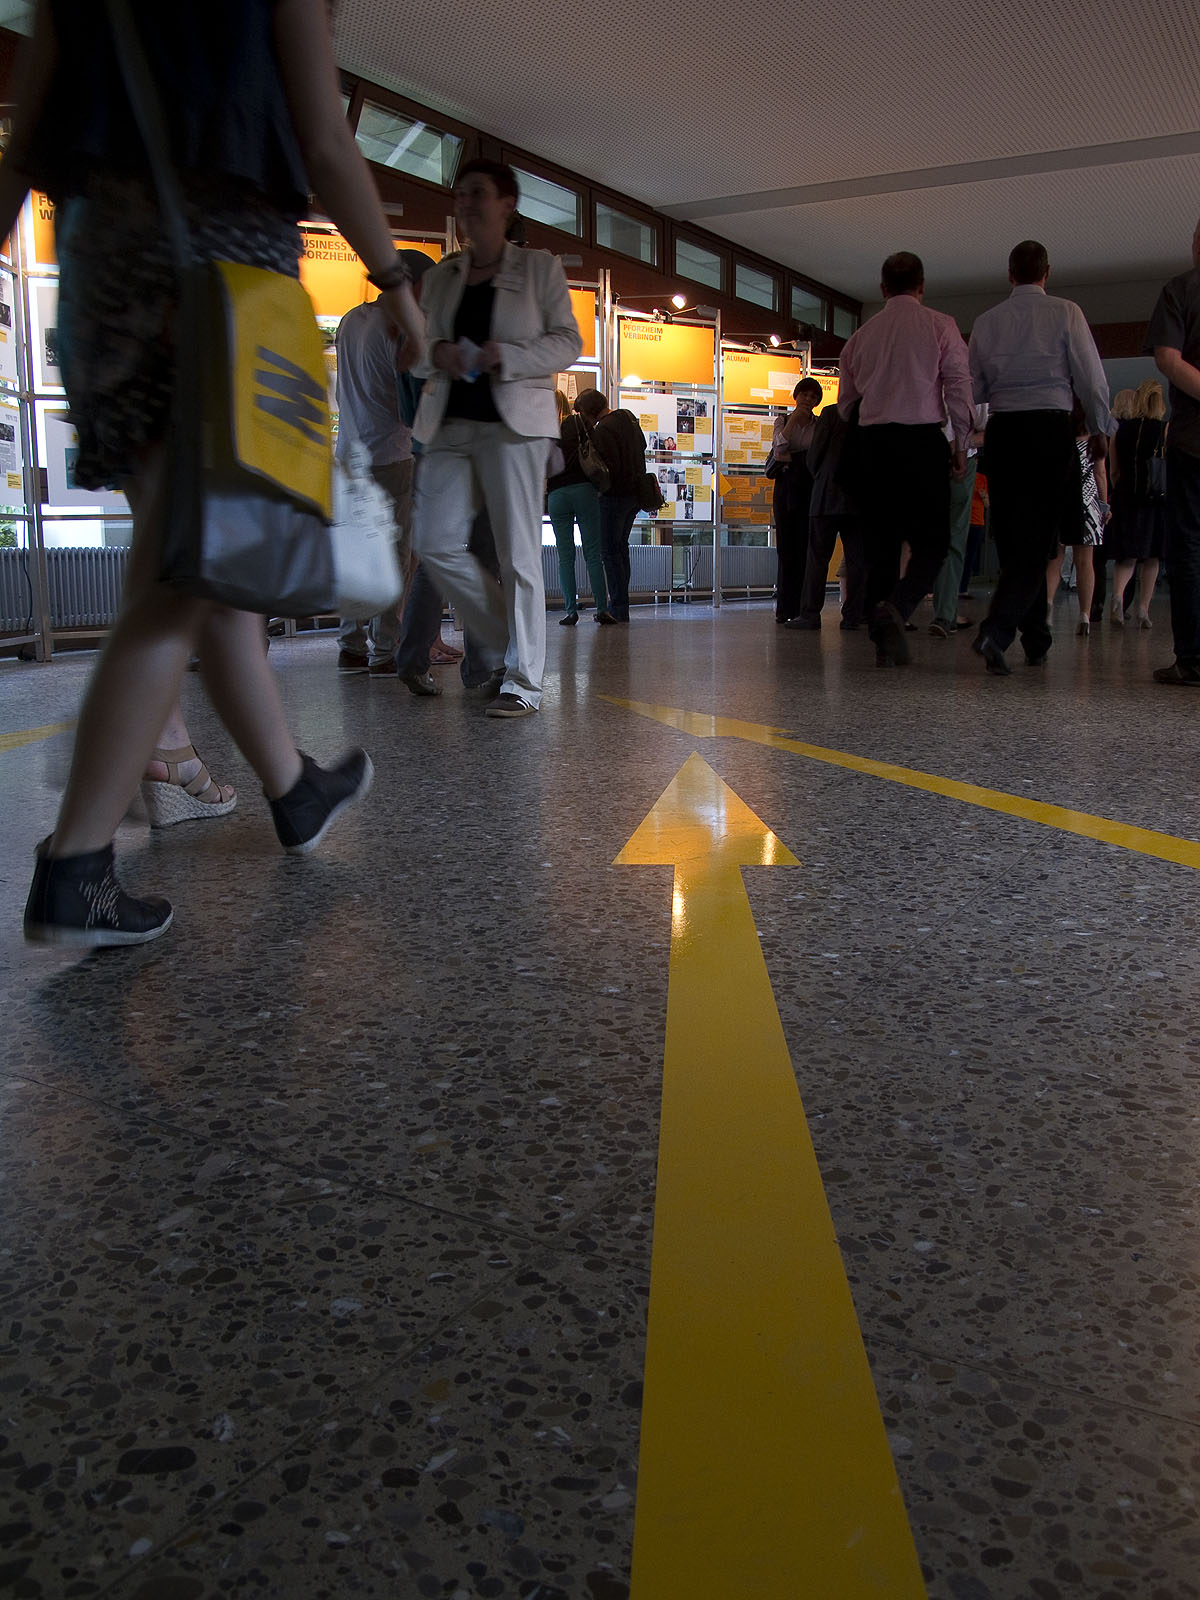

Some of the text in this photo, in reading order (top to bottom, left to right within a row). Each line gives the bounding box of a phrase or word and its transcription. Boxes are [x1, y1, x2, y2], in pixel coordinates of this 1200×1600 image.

[303, 239, 347, 251] USINESS
[301, 249, 358, 262] FORZHEIM
[623, 324, 663, 334] PFORZHEIM
[623, 332, 662, 341] VERBINDET
[726, 354, 750, 363] ALUMNI
